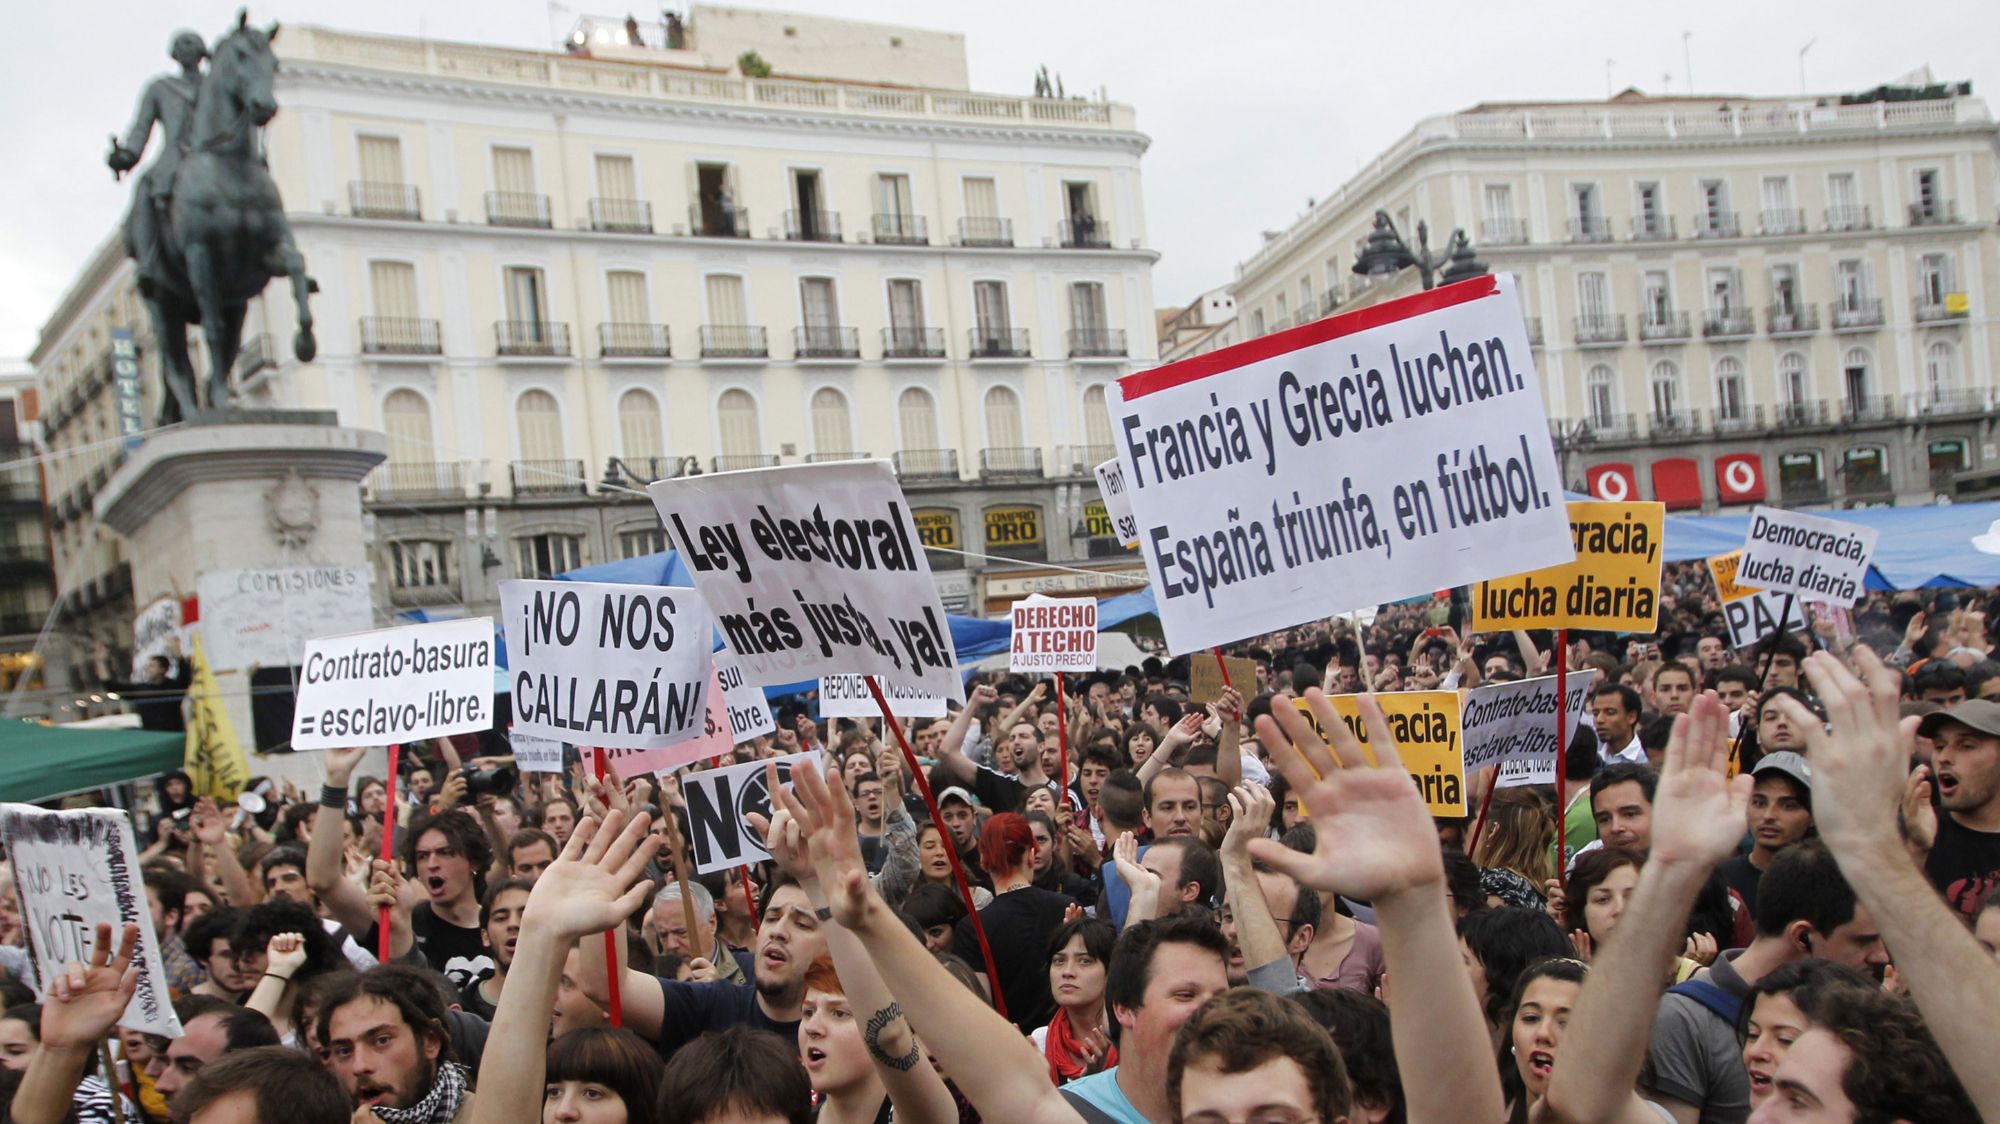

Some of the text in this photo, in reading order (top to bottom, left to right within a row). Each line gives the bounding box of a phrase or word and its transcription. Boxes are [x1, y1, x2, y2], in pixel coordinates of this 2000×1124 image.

[113, 338, 139, 432] HOTEL
[1122, 330, 1525, 488] Francia y Grecia luchan.
[912, 514, 952, 526] MPRO
[918, 526, 953, 546] RO
[984, 510, 1035, 523] COMPRO
[986, 521, 1037, 541] ORO
[1087, 517, 1115, 536] OR
[1150, 434, 1551, 609] España triunfa, en fútbol.
[670, 501, 918, 583] Ley electoral
[1752, 515, 1866, 567] Democracia,
[238, 570, 356, 594] COMISIONES
[1022, 577, 1066, 592] CASA
[1075, 574, 1096, 589] DE
[1481, 575, 1654, 619] lucha diaria
[1741, 553, 1856, 600] lucha diaria
[523, 590, 676, 656] ¡NO NOS
[719, 589, 953, 677] más justa, ya!
[1014, 604, 1096, 629] DERECHO
[306, 638, 489, 684] Contrato-basura
[1012, 654, 1095, 666] A JUSTO PRECIO!
[1013, 630, 1095, 653] A TECHO
[516, 667, 702, 735] CALLARÁN!
[824, 674, 868, 699] REPONED
[320, 690, 486, 737] esclavo-libre.
[1463, 687, 1583, 730] Contrato-basra
[27, 862, 88, 901] NO LES
[33, 907, 113, 967] VOTE
